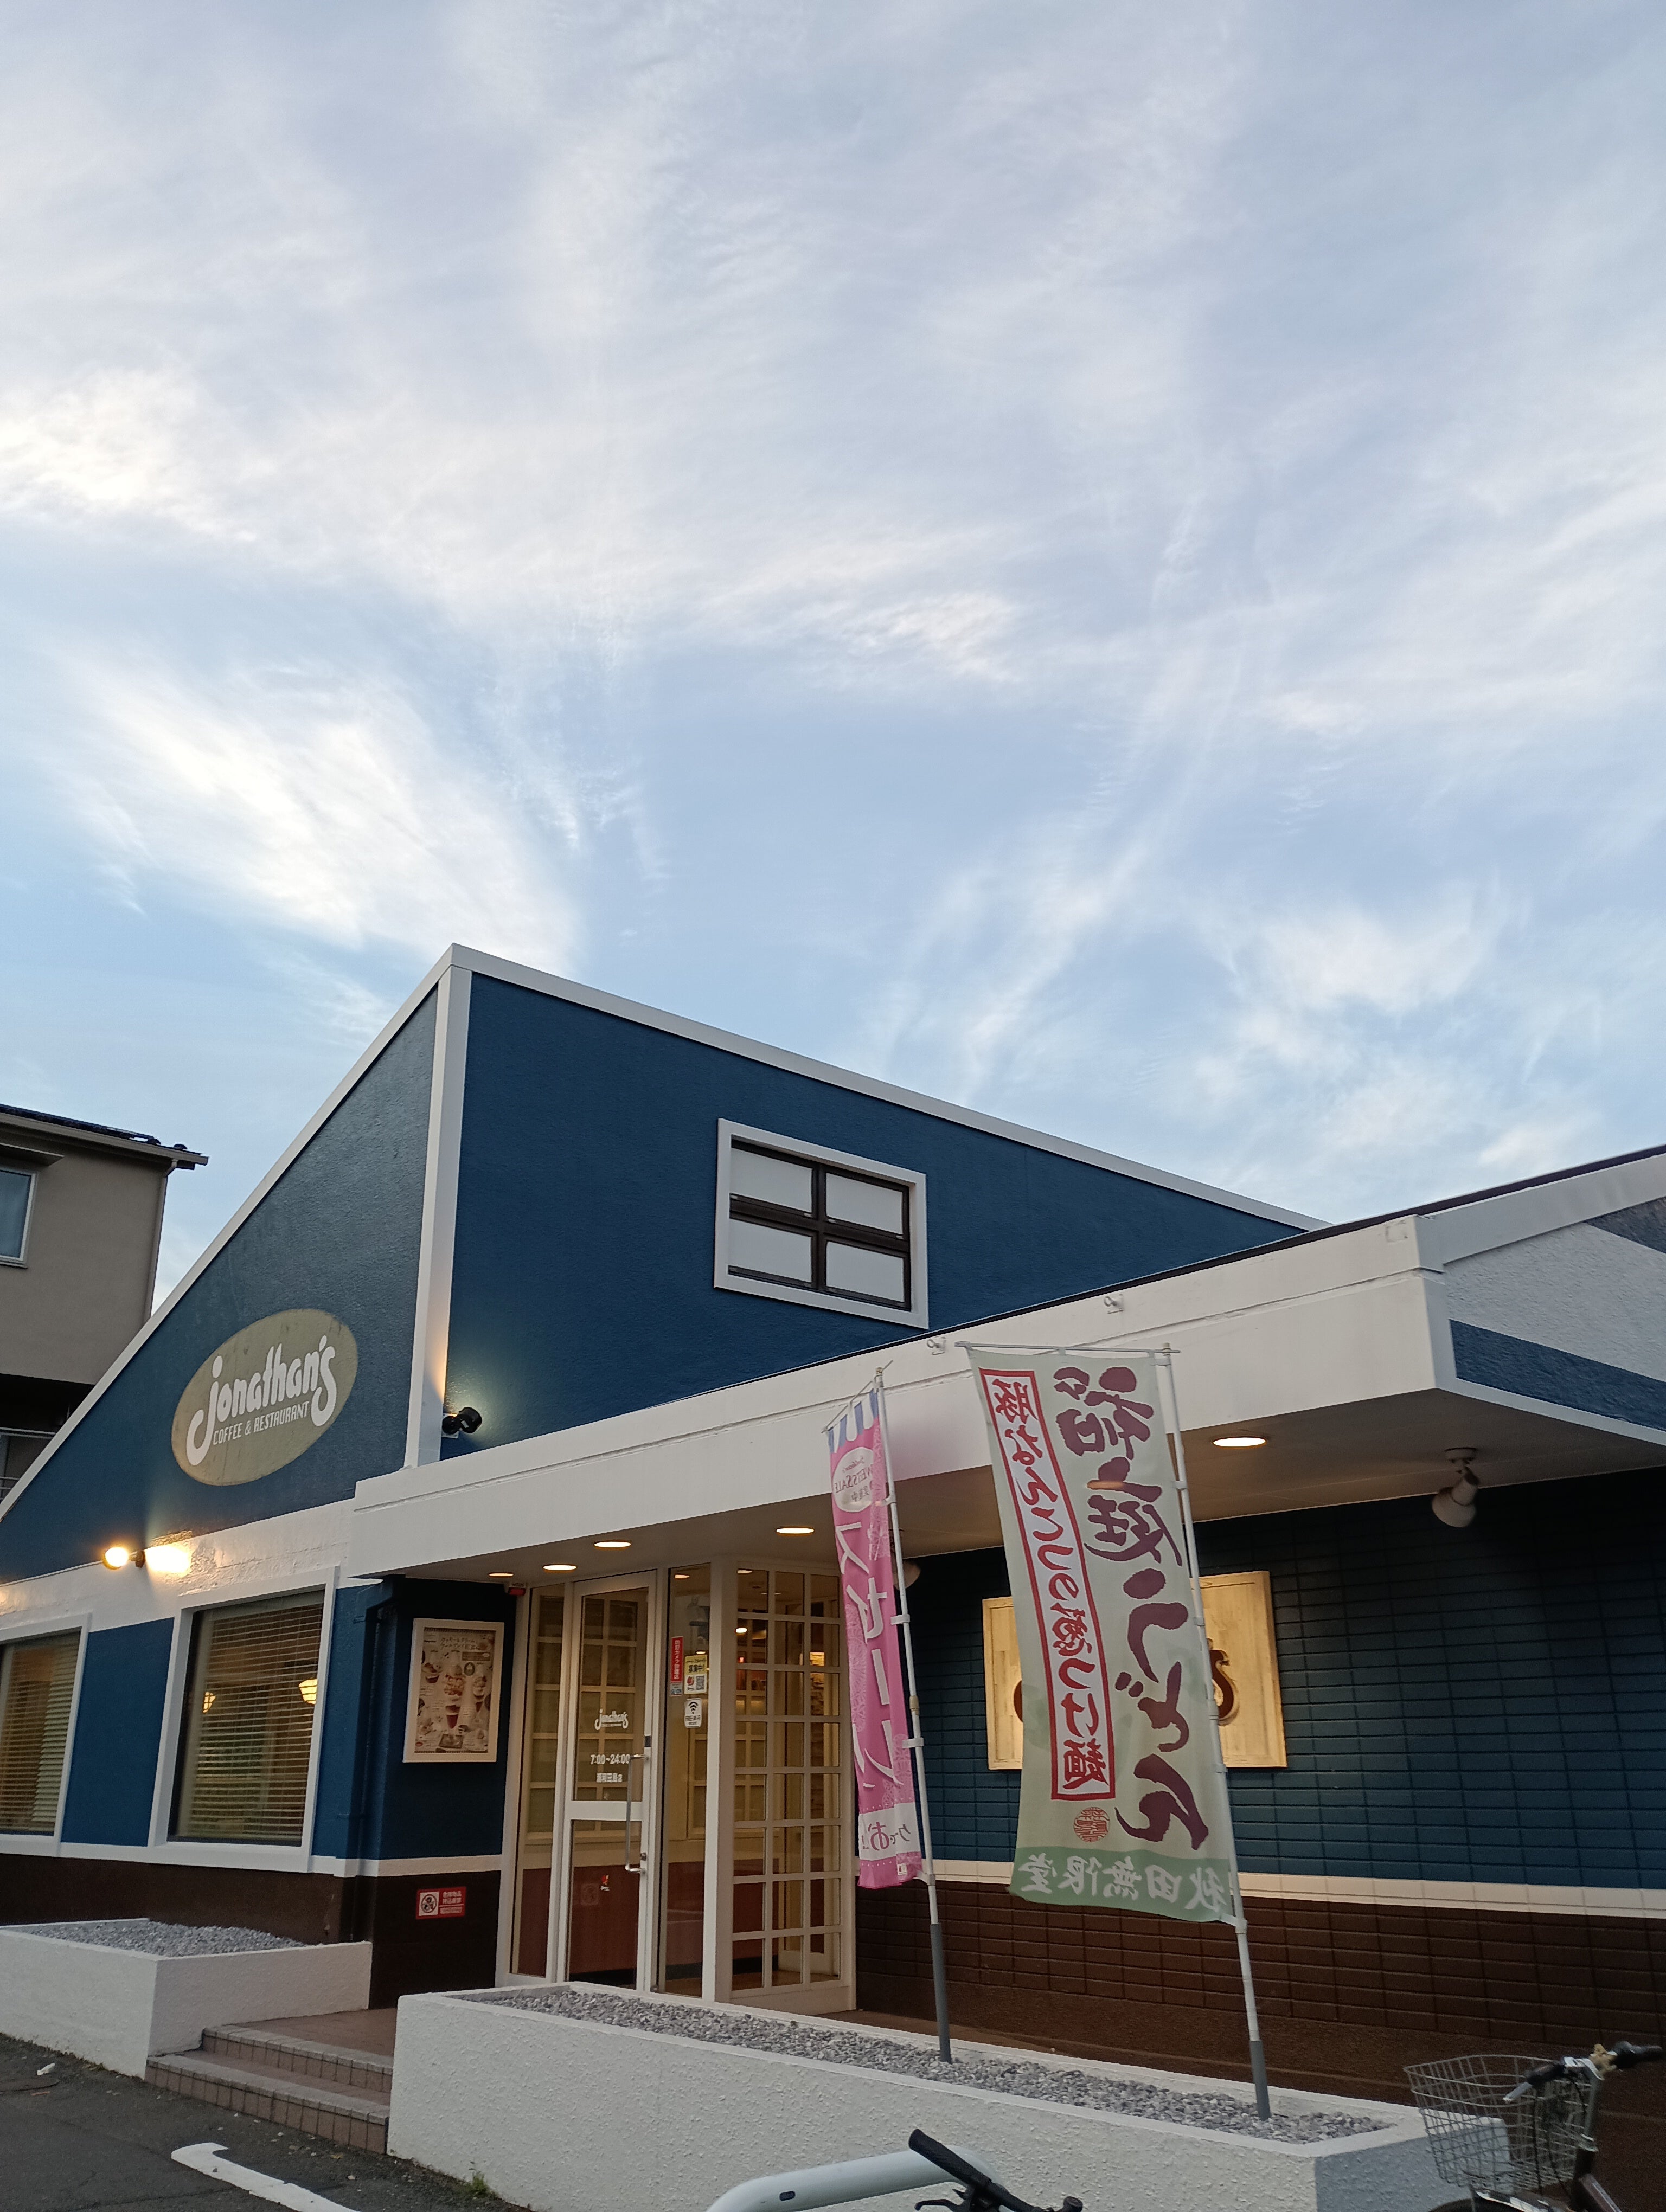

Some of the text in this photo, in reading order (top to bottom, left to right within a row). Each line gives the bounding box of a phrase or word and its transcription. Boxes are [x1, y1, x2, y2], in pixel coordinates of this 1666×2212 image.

[213, 1400, 310, 1445] COFFEE & RESTAURANT
